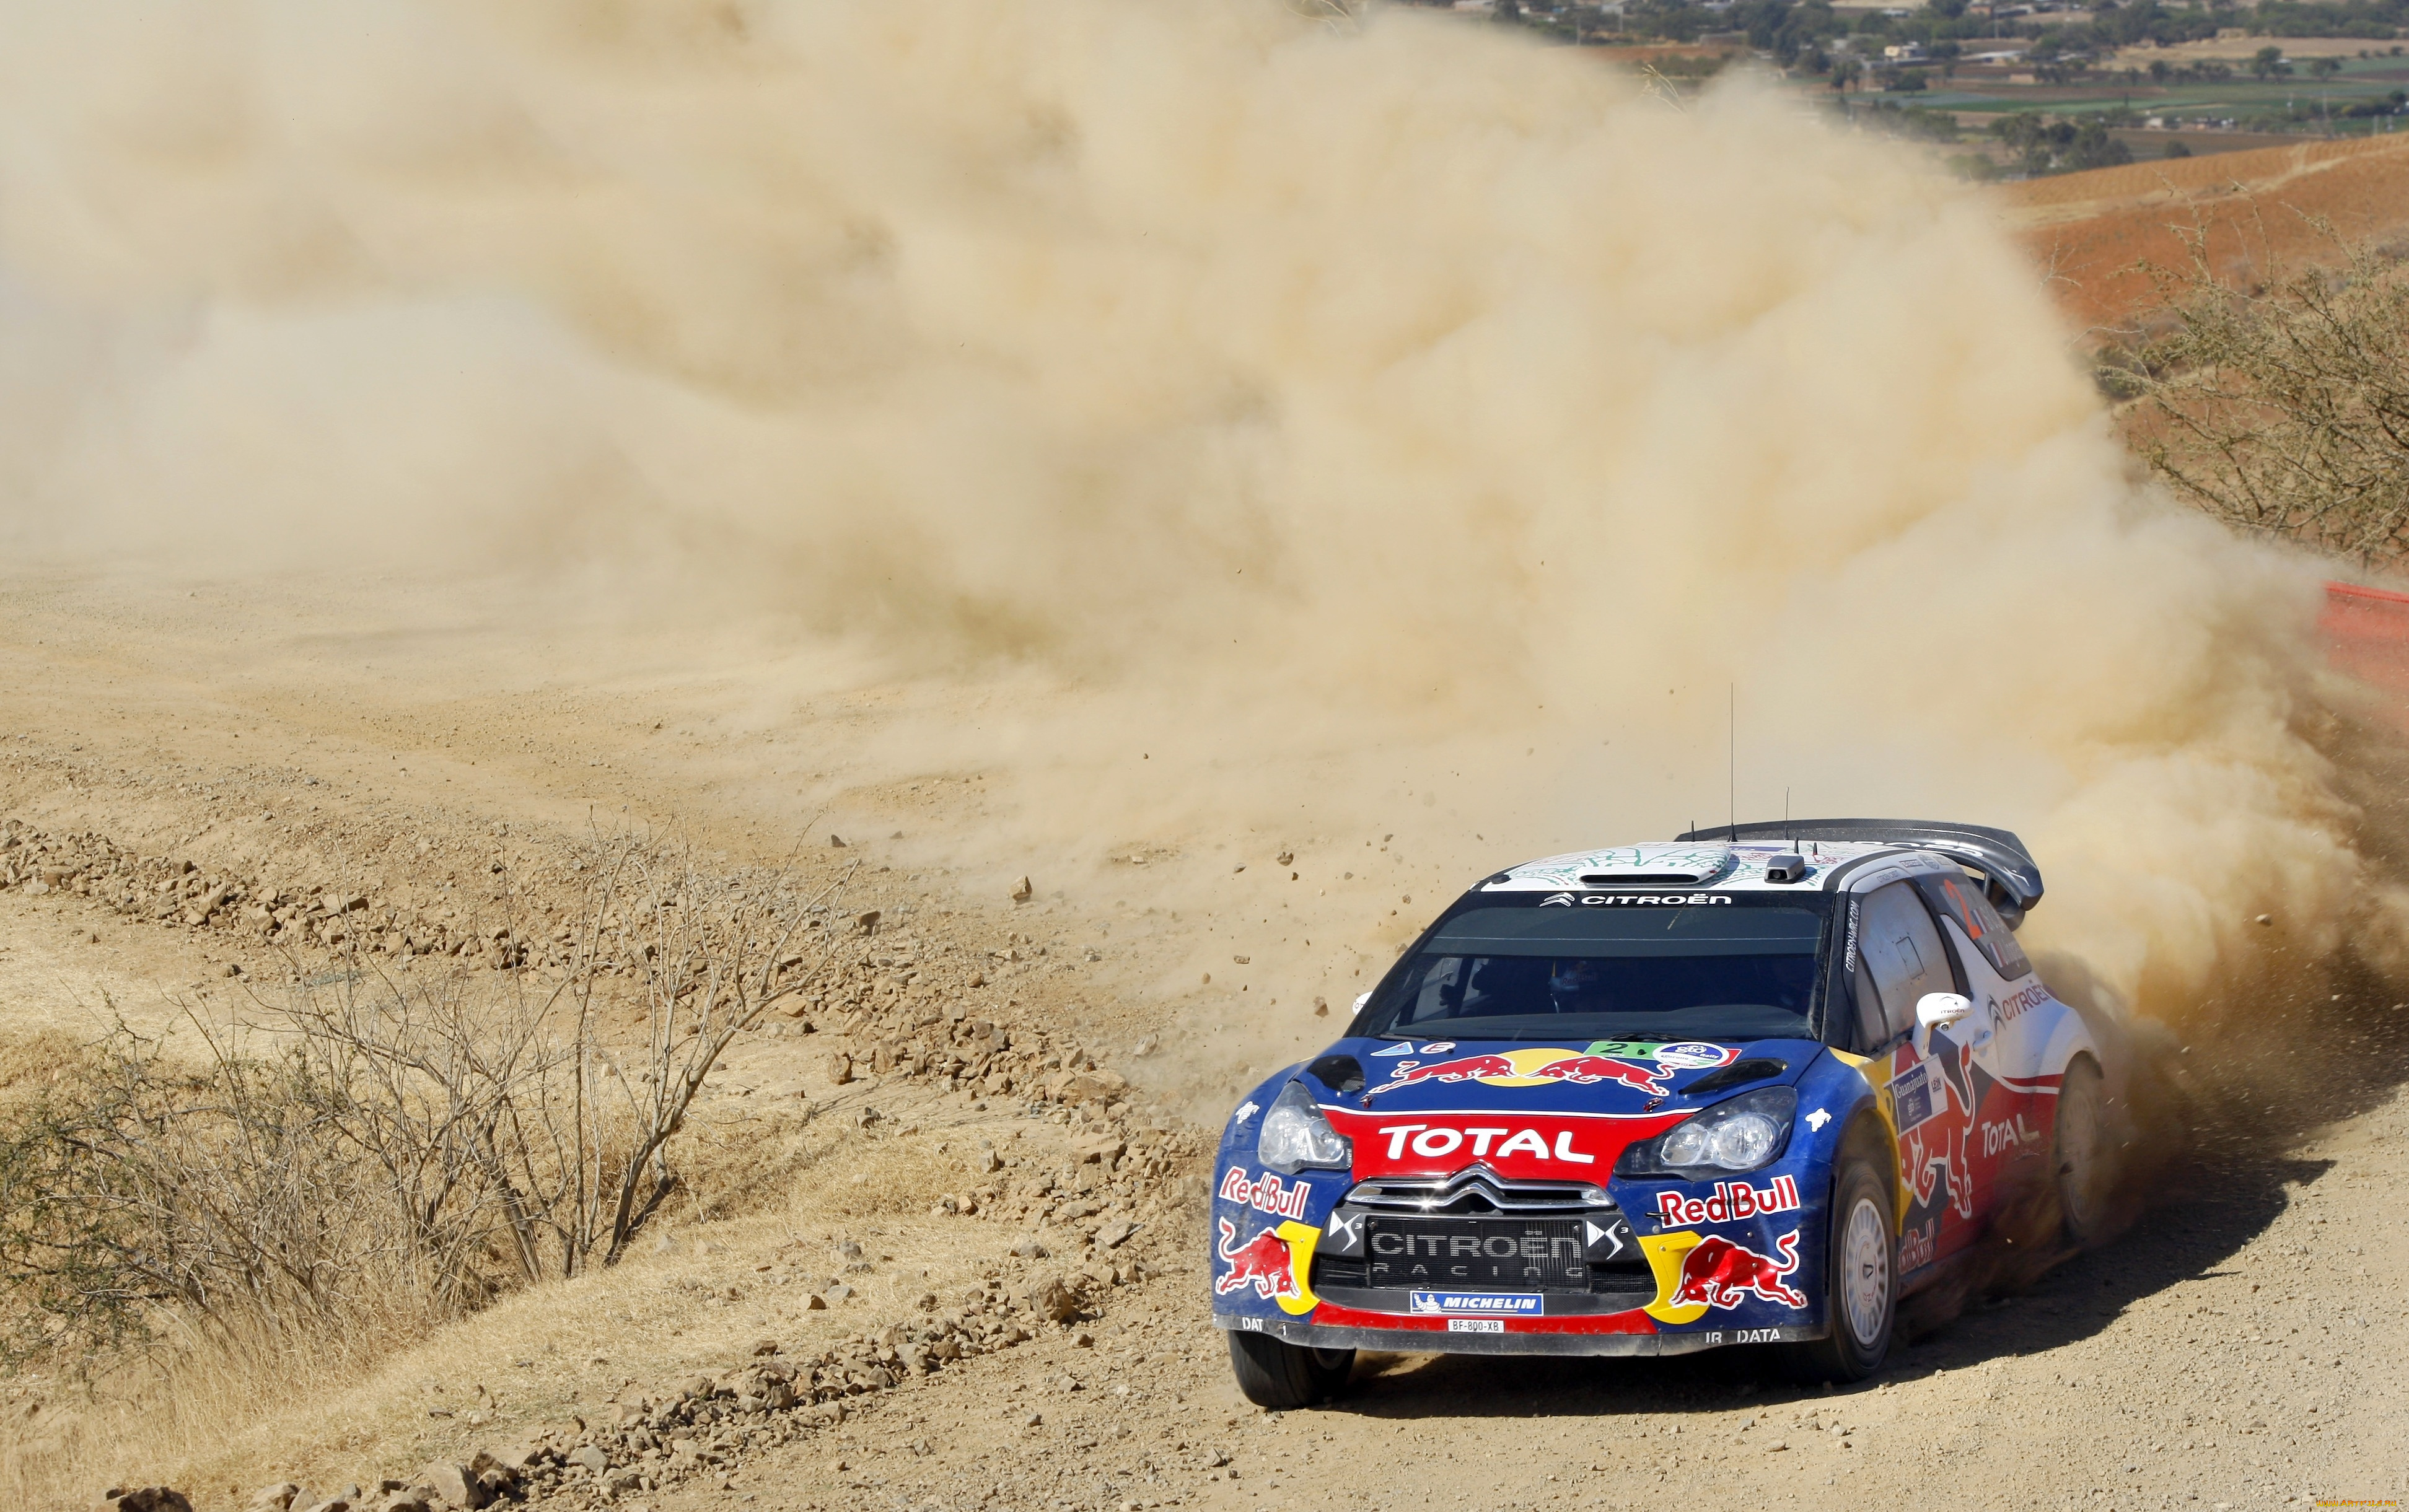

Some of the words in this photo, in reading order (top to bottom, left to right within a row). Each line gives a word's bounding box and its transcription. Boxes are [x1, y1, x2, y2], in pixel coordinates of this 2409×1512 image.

[1944, 879, 1983, 940] 2
[1599, 1043, 1629, 1054] 2
[1895, 1071, 1928, 1098] Guanajuato
[1378, 1124, 1595, 1164] TOTAL
[1981, 1114, 2040, 1158] TOTAL
[1443, 1297, 1537, 1309] MICHELIN
[1453, 1321, 1499, 1331] BF-800-XB
[1737, 1329, 1781, 1343] DATA
